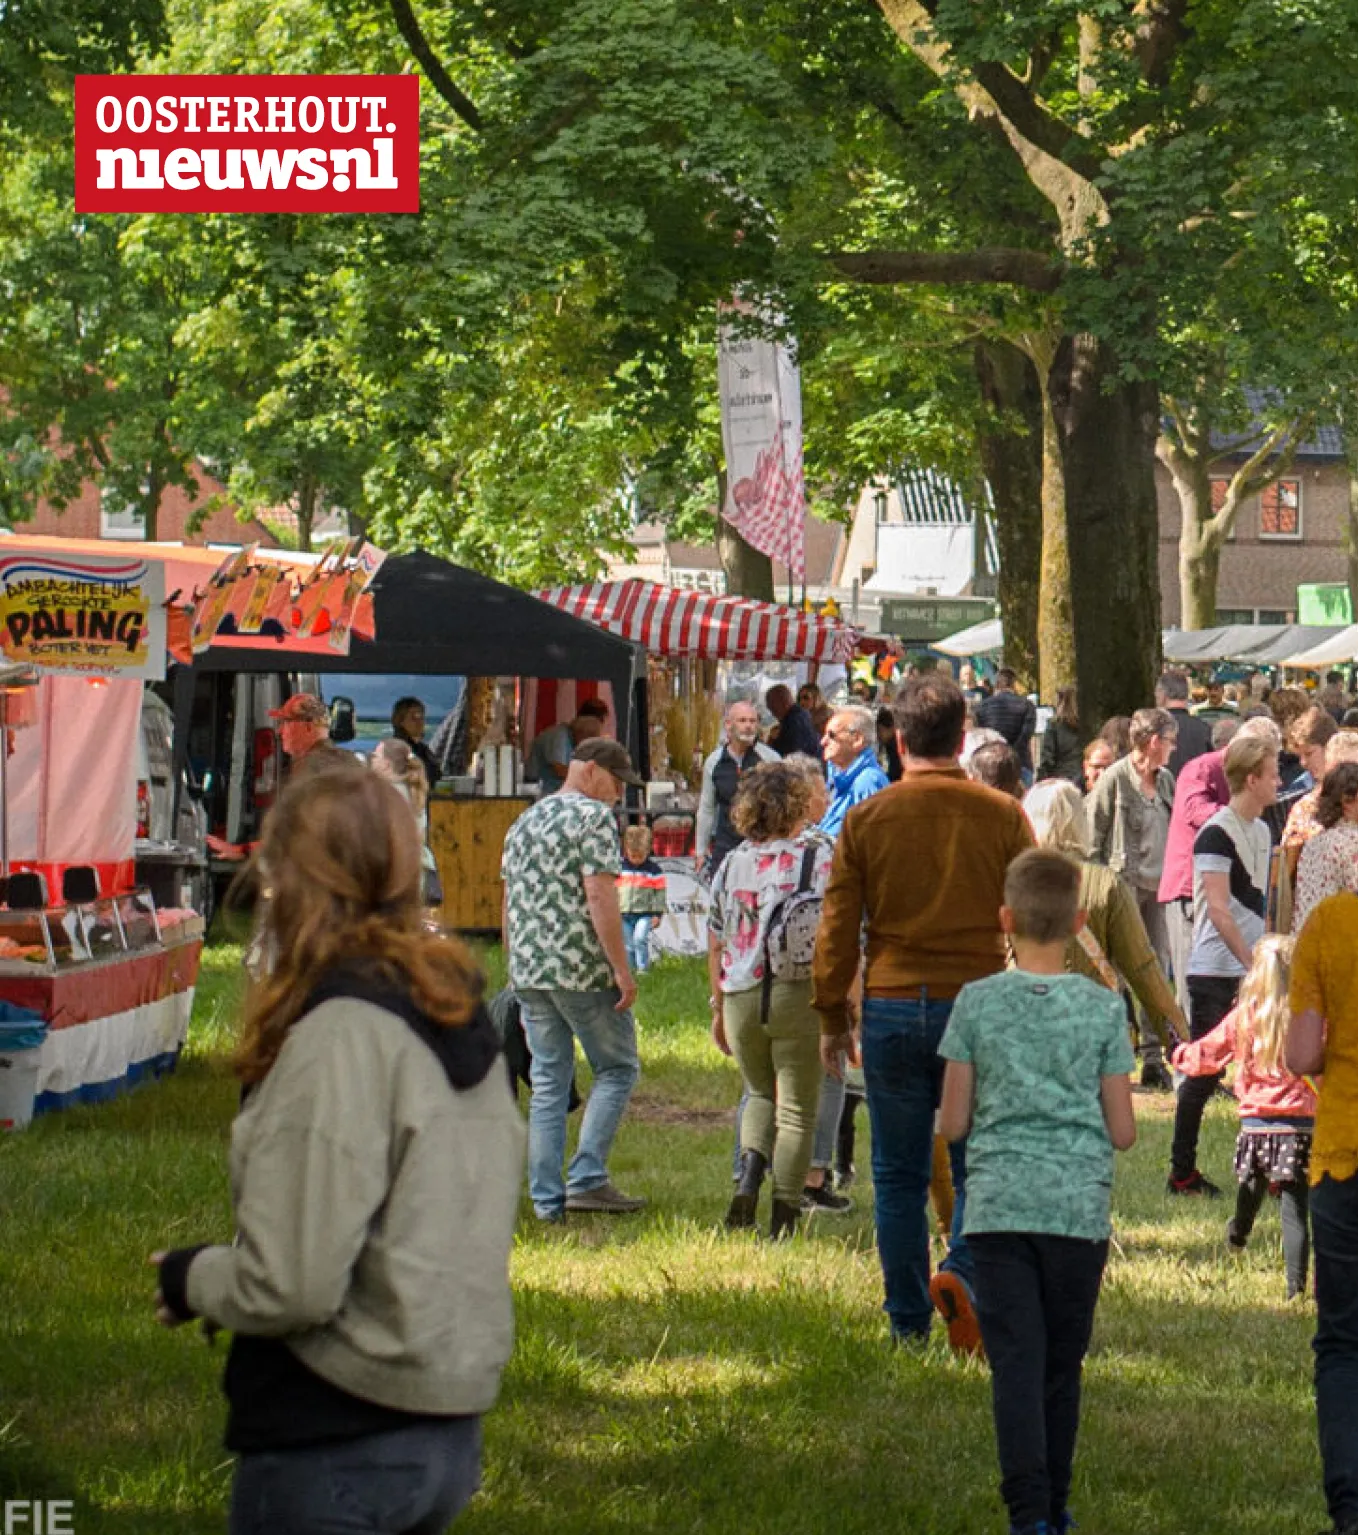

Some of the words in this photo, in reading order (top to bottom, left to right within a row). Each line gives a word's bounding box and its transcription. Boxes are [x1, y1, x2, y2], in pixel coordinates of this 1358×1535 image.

[6, 578, 141, 598] AMBACHTELIJK
[26, 593, 112, 610] GEROOKTE
[6, 608, 144, 652] PALING
